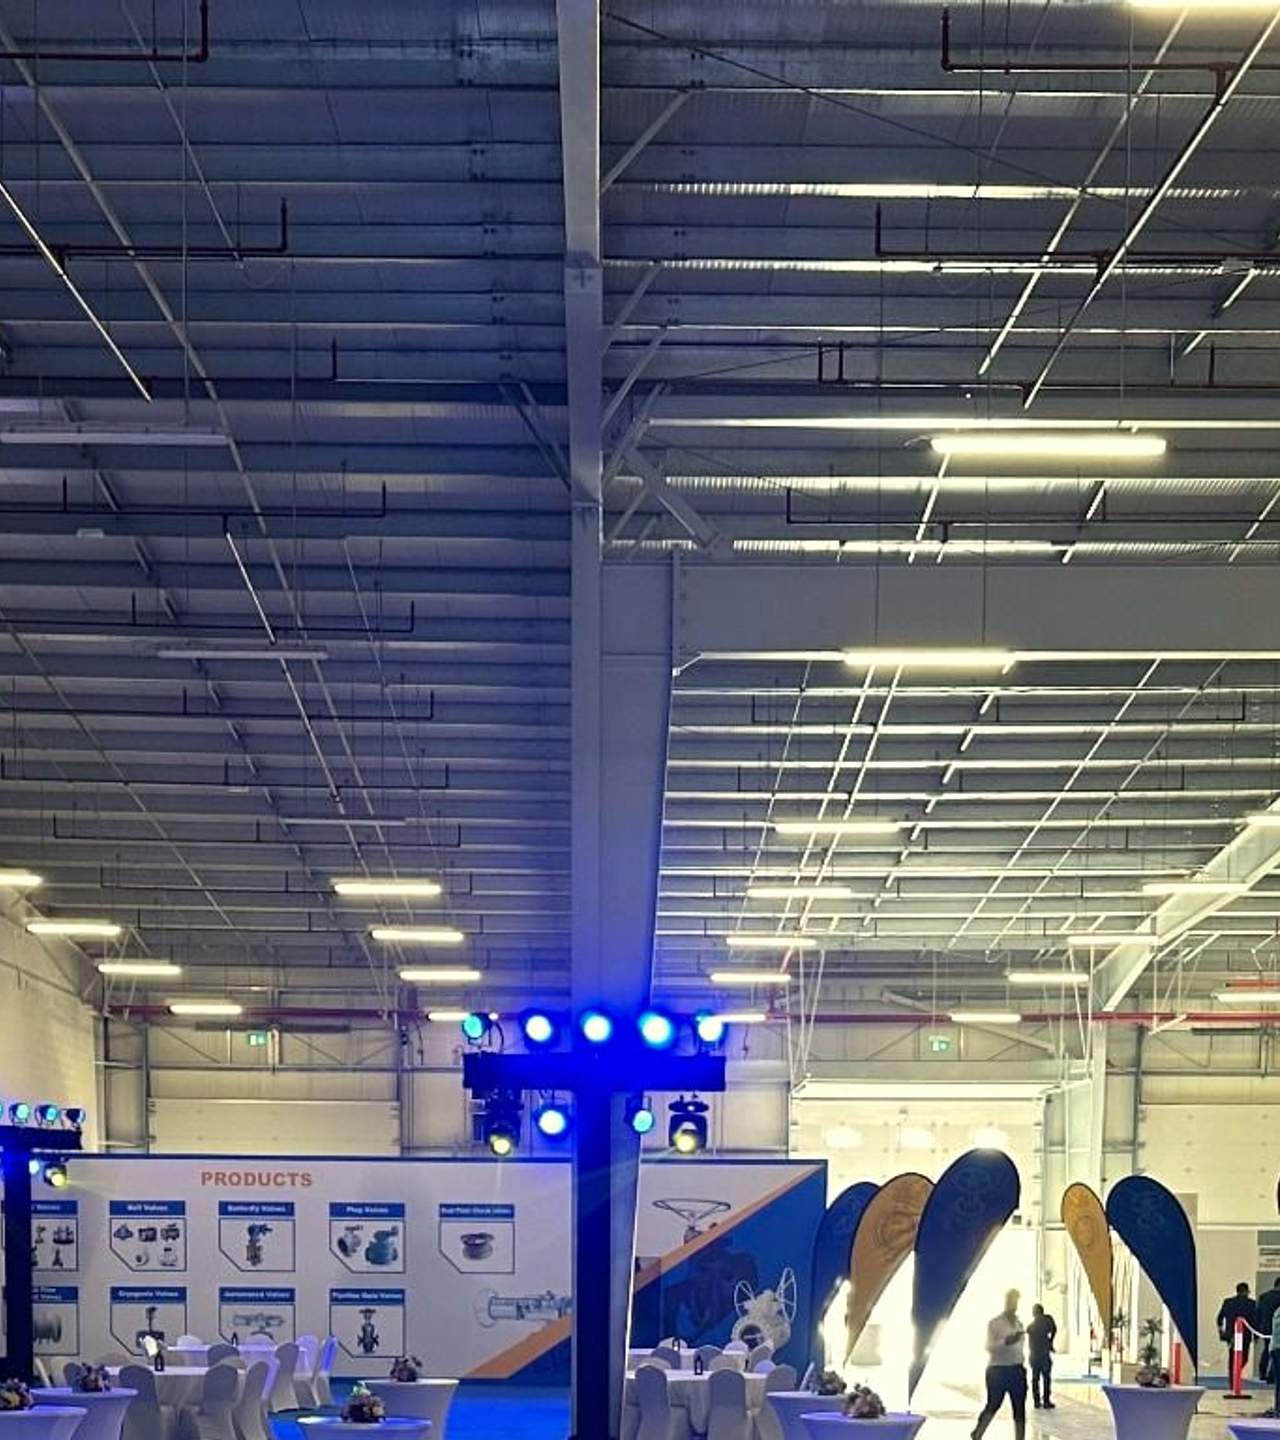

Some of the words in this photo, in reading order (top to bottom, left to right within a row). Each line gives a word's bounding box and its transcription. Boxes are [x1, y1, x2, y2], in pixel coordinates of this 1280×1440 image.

[200, 1171, 313, 1187] PRODUCTS
[144, 1204, 168, 1212] Valves
[346, 1206, 363, 1215] Plug
